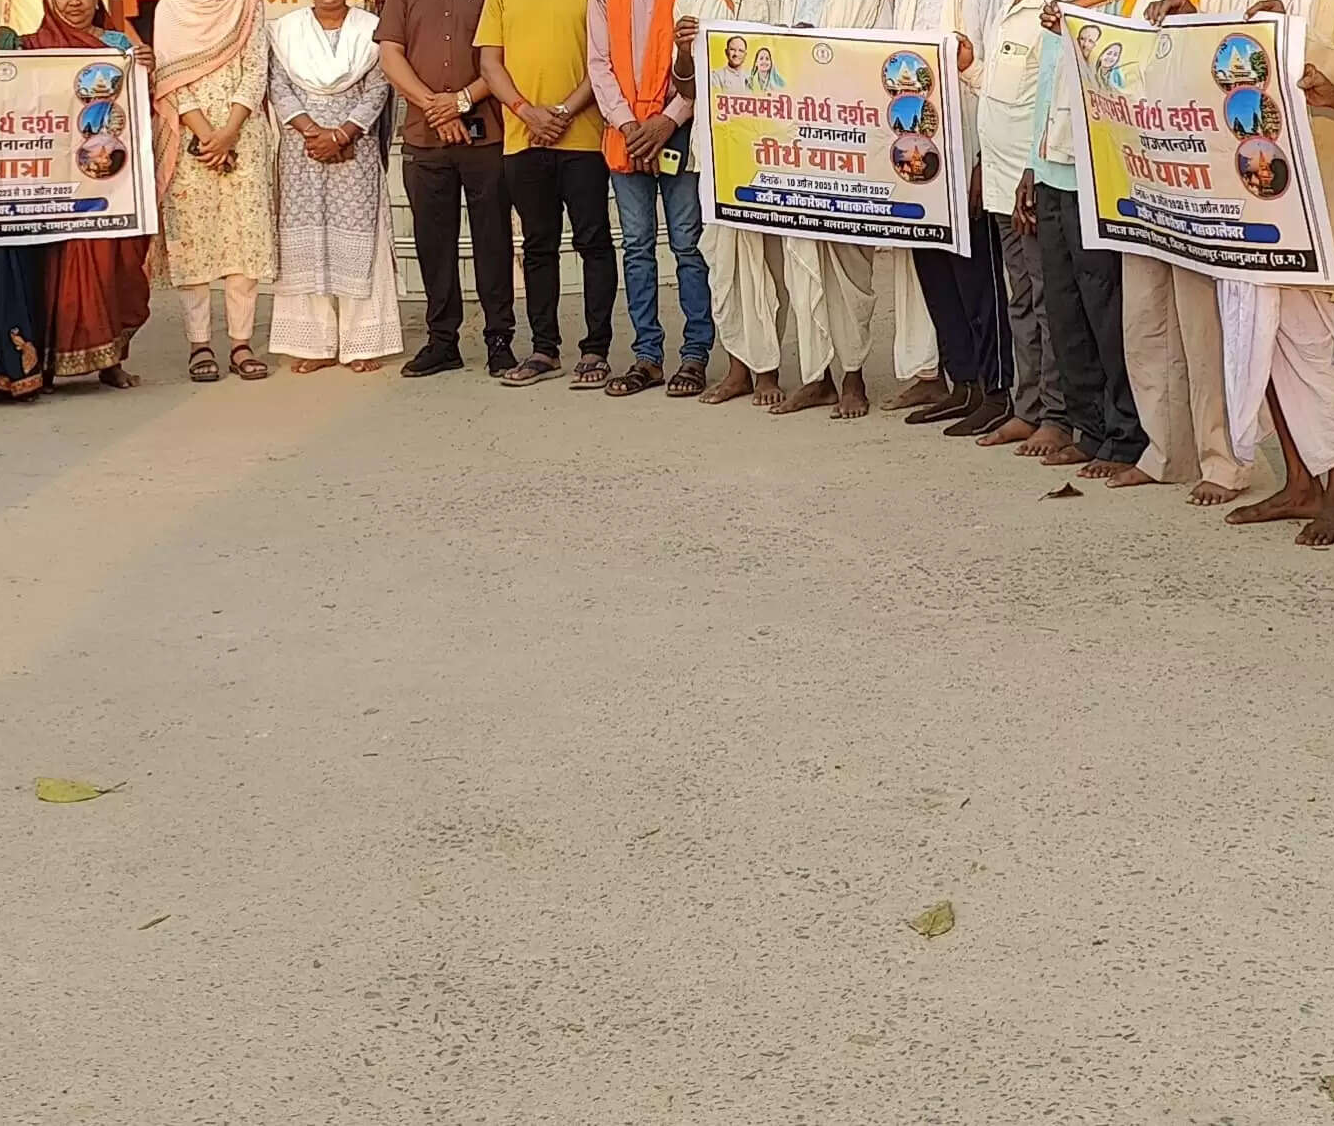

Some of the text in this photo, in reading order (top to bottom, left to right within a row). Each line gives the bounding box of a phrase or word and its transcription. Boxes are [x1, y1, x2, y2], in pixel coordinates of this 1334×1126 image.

[21, 110, 69, 134] दर्शन
[716, 92, 880, 127] मुख्यमंत्री तीर्थ दर्शन
[1167, 100, 1219, 131] दर्शन
[753, 137, 867, 174] तीर्थ यात्रा
[1152, 160, 1212, 189] यात्रा
[1220, 204, 1240, 214] 2025
